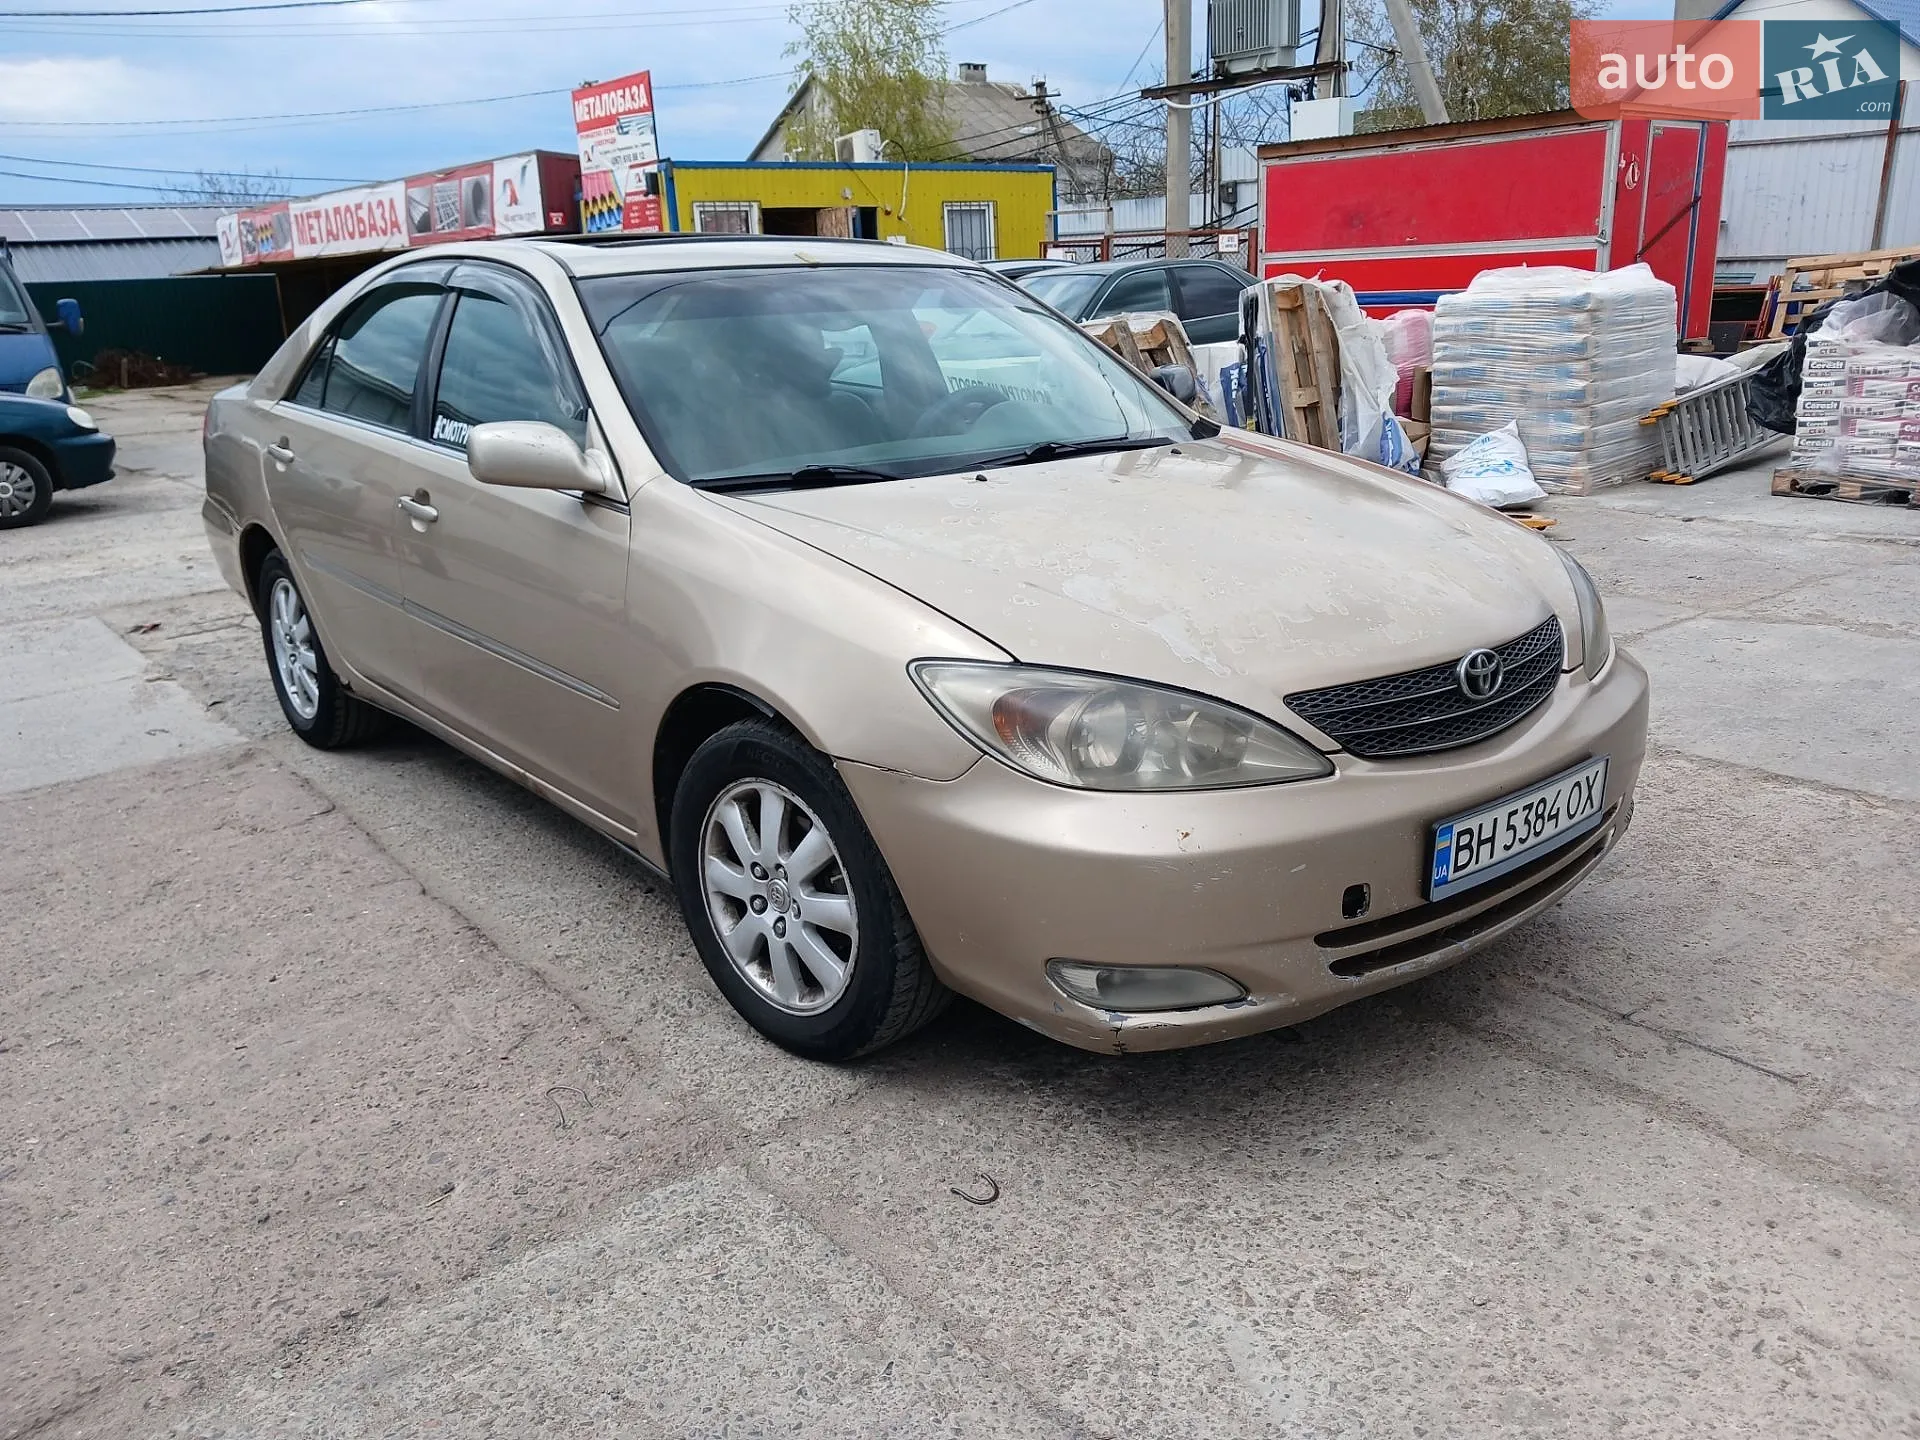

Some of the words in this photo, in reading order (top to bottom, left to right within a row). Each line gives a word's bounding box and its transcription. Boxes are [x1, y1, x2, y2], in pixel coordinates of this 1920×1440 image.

[574, 83, 649, 123] МЕТАЛОБАЗА
[294, 197, 402, 246] МЕТАЛОБАЗА
[1452, 816, 1498, 875] BH
[1503, 788, 1562, 852] 5384
[1566, 770, 1600, 822] OX
[1434, 866, 1448, 881] UA
